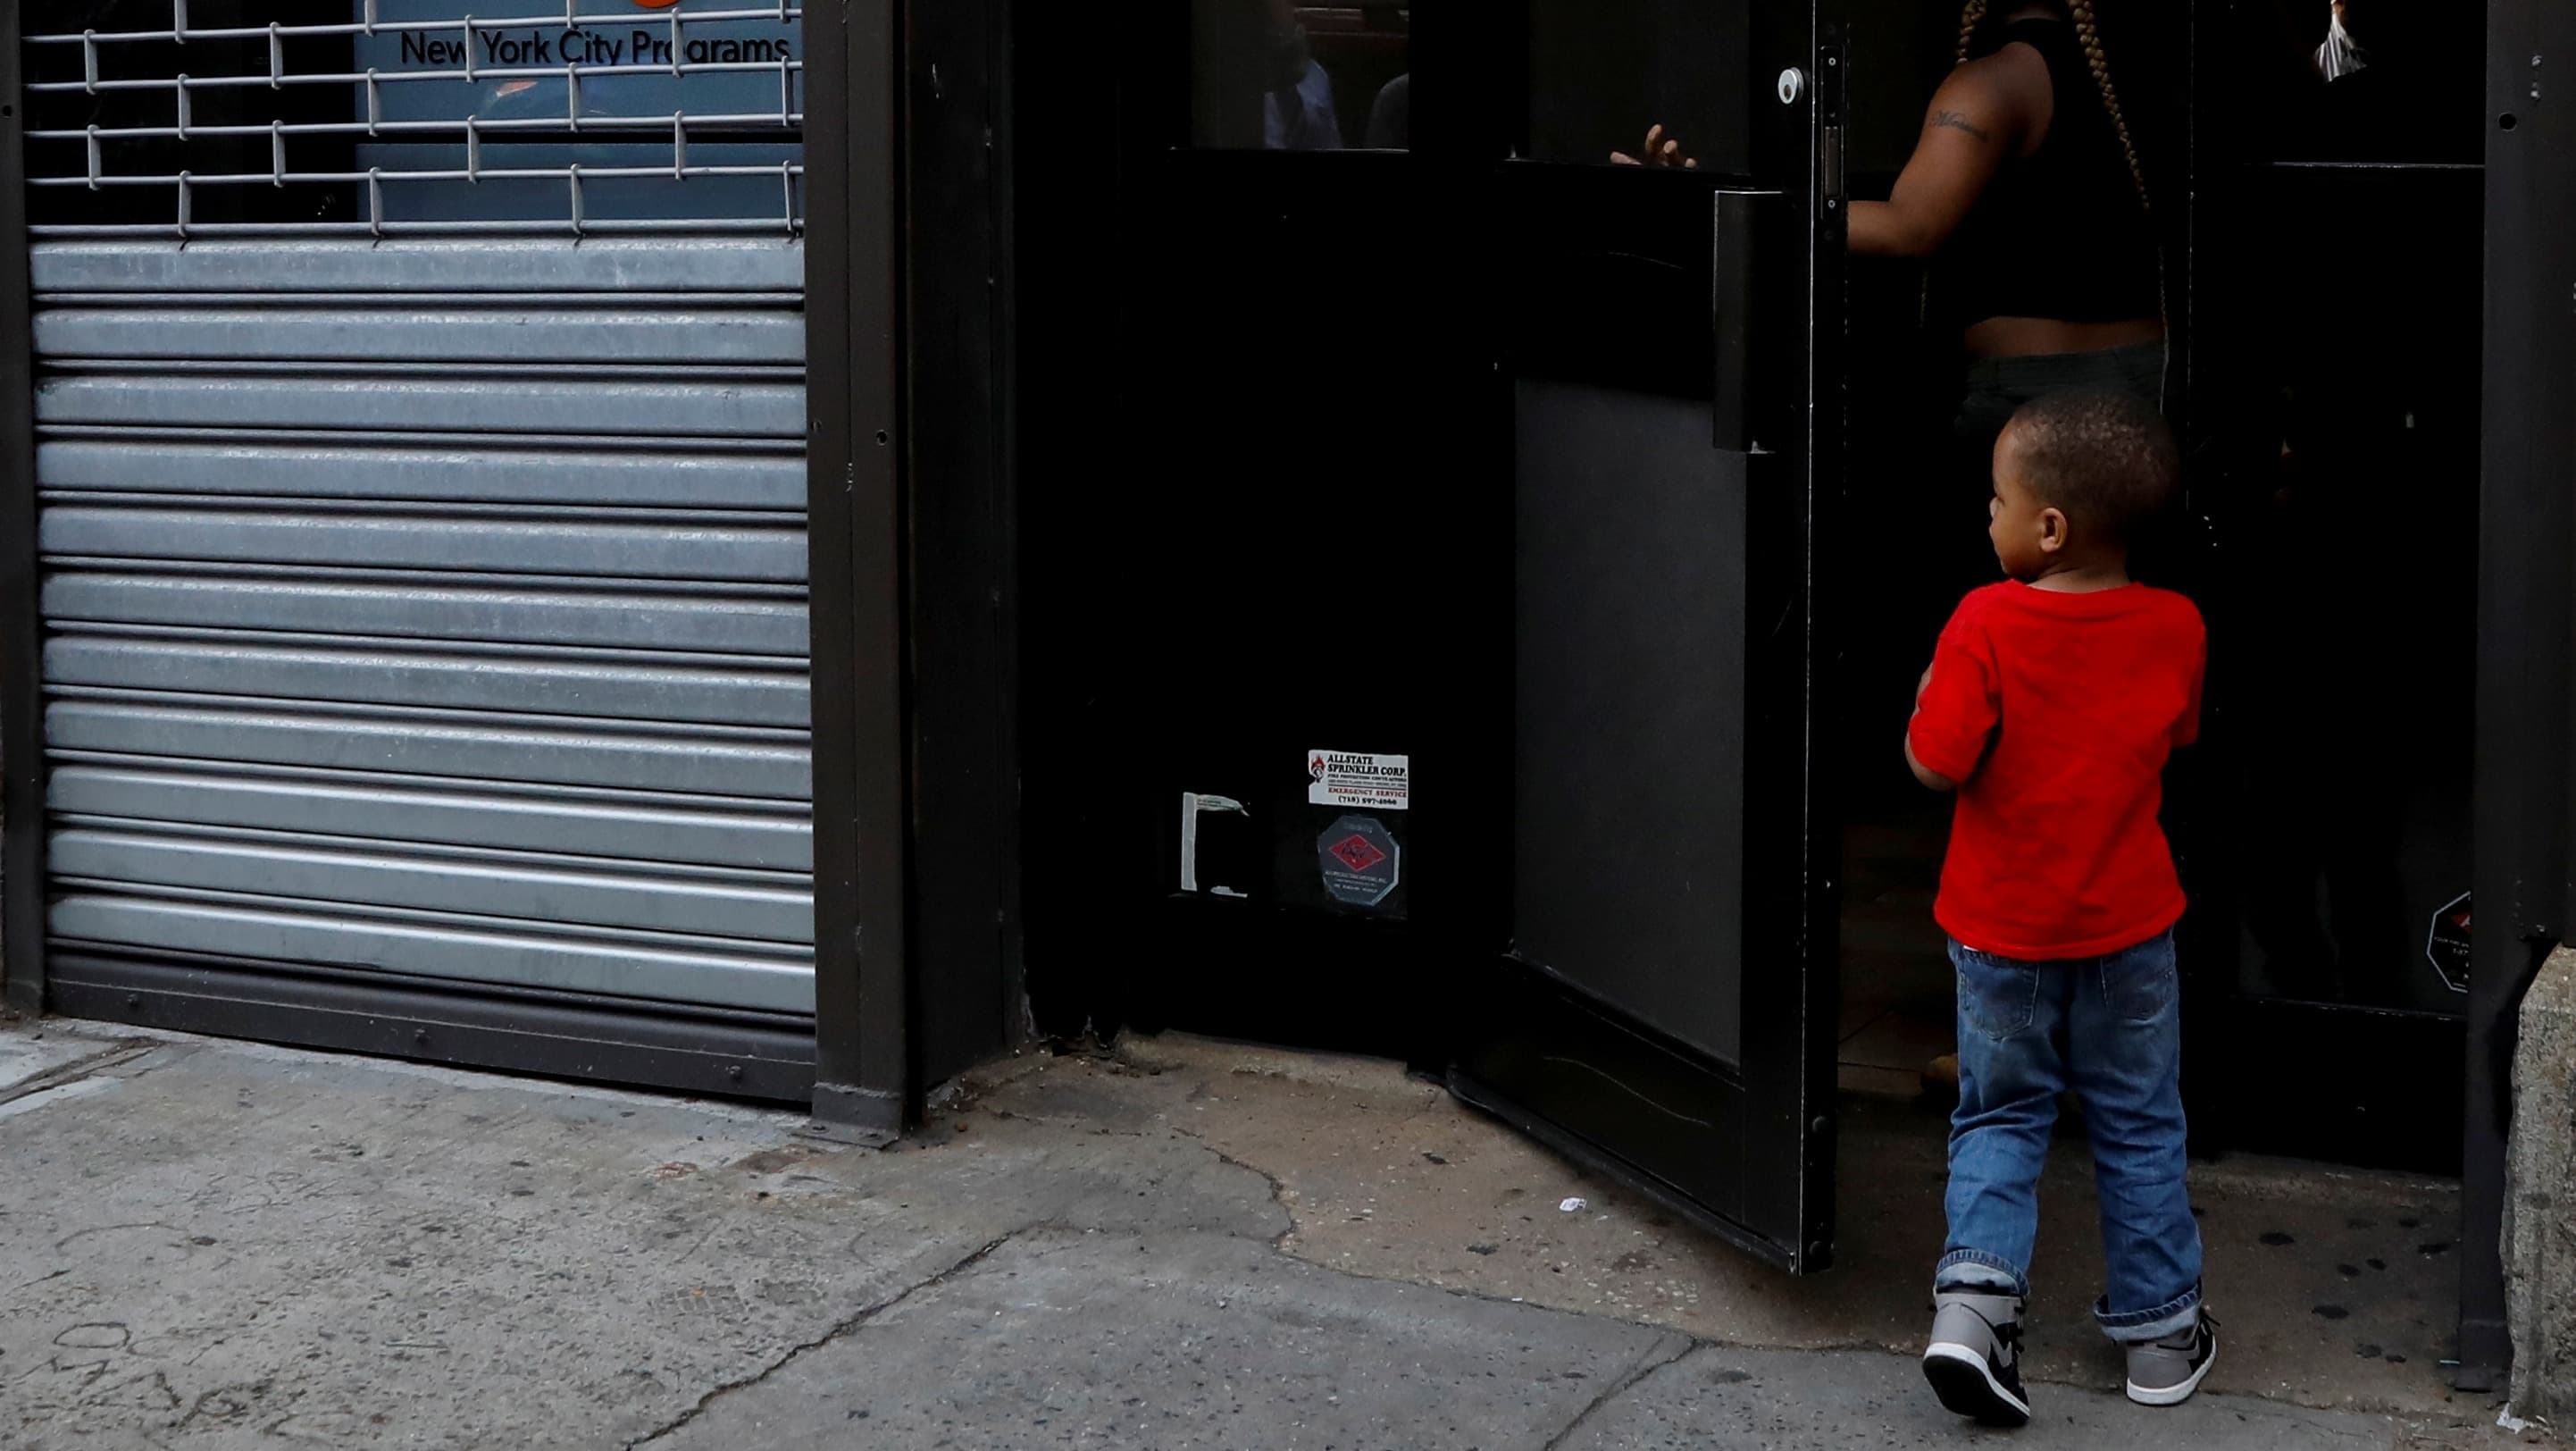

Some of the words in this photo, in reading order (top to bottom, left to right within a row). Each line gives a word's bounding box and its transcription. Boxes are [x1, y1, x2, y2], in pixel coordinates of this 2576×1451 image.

[402, 30, 467, 64] New
[481, 30, 552, 64] York
[559, 30, 623, 66] City
[1327, 754, 1373, 765] ALLSTATE
[1327, 764, 1379, 775] SPRINKLER
[1381, 767, 1407, 776] CORP.
[1328, 787, 1372, 795] EMERGENCY
[1338, 795, 1359, 804] (718)
